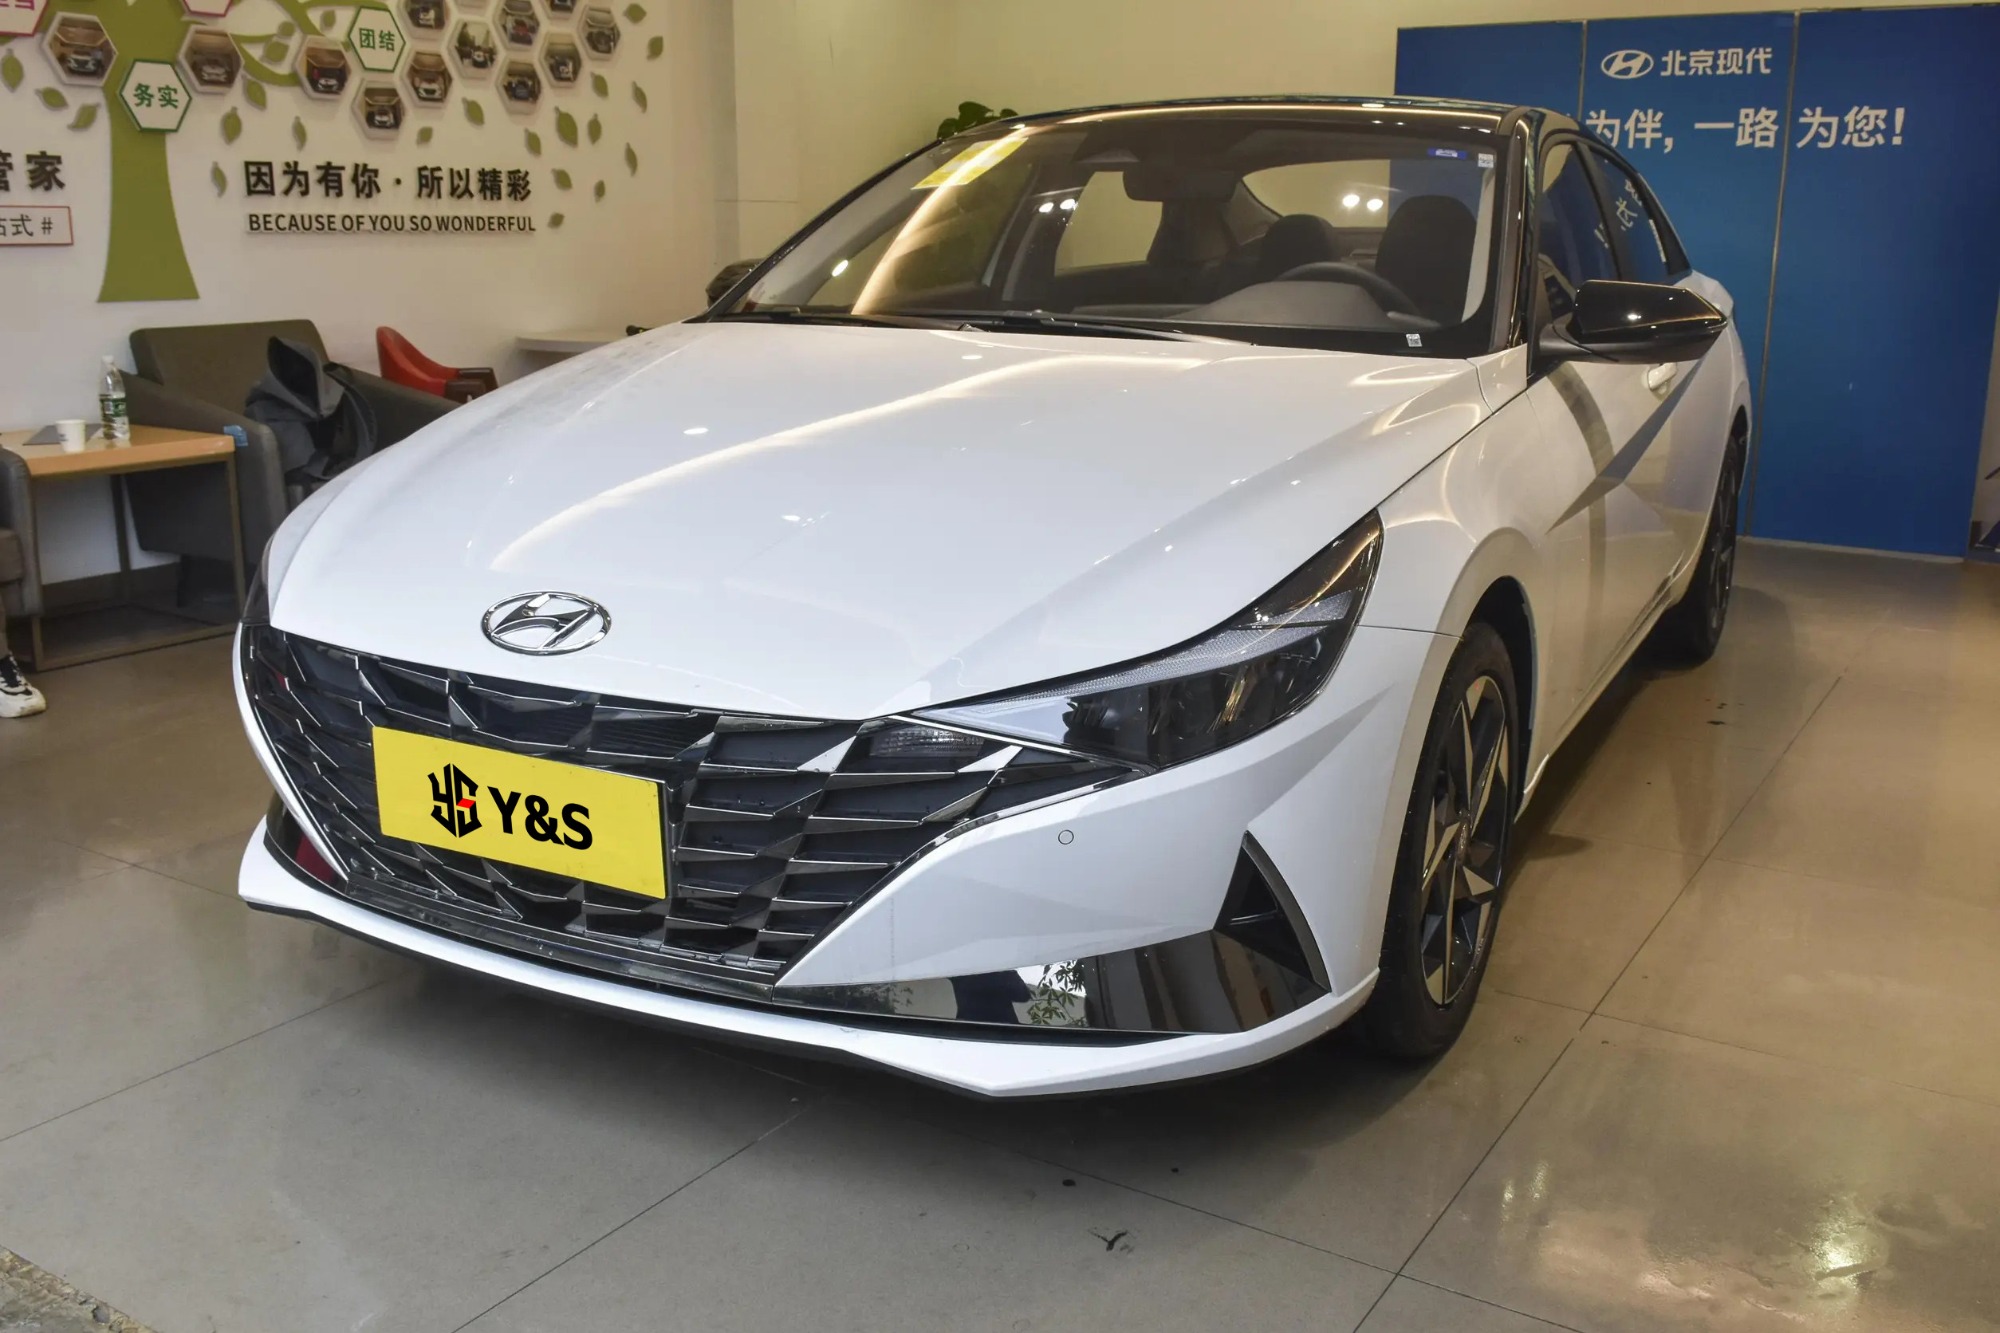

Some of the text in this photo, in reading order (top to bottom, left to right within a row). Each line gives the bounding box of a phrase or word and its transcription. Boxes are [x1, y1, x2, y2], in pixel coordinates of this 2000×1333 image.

[359, 28, 395, 51] 团结
[1660, 47, 1773, 76] 北京现代
[133, 83, 178, 109] 务实
[249, 213, 536, 232] BECAUSE OF YOU SO WONDERFUL
